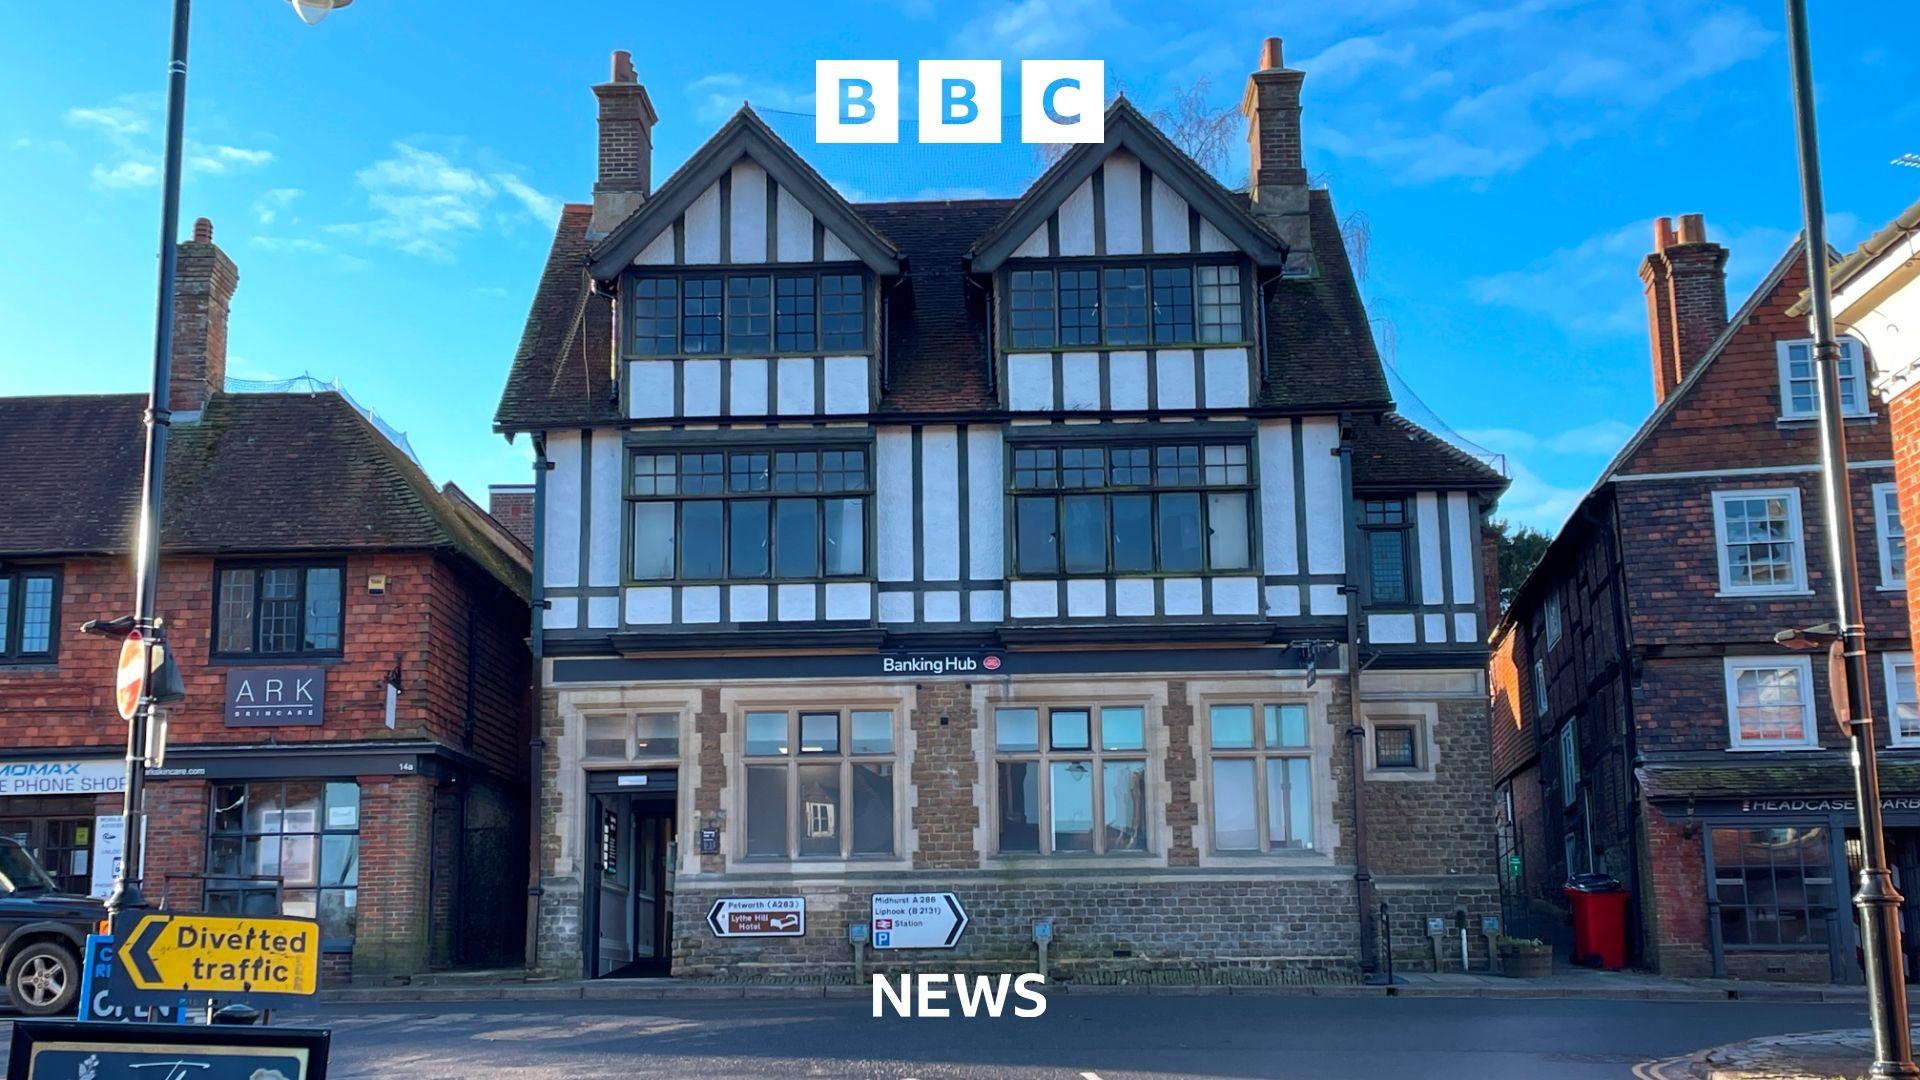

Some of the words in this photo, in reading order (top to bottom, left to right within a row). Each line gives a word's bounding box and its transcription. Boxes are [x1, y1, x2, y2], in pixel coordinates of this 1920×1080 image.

[883, 656, 943, 674] Banking
[945, 656, 977, 671] Hub
[235, 678, 314, 703] ARK
[234, 709, 314, 718] SKINCARE
[14, 778, 75, 793] PHONE
[1753, 799, 1856, 811] HEADCASE
[728, 901, 765, 909] Petworth
[875, 896, 909, 904] Midhurst
[875, 907, 906, 917] Liphook
[731, 914, 753, 924] Lythe
[754, 913, 769, 922] Hill
[894, 920, 923, 928] Station
[738, 922, 761, 931] Hotel
[177, 926, 306, 953] Diverted
[192, 955, 288, 982] traffic
